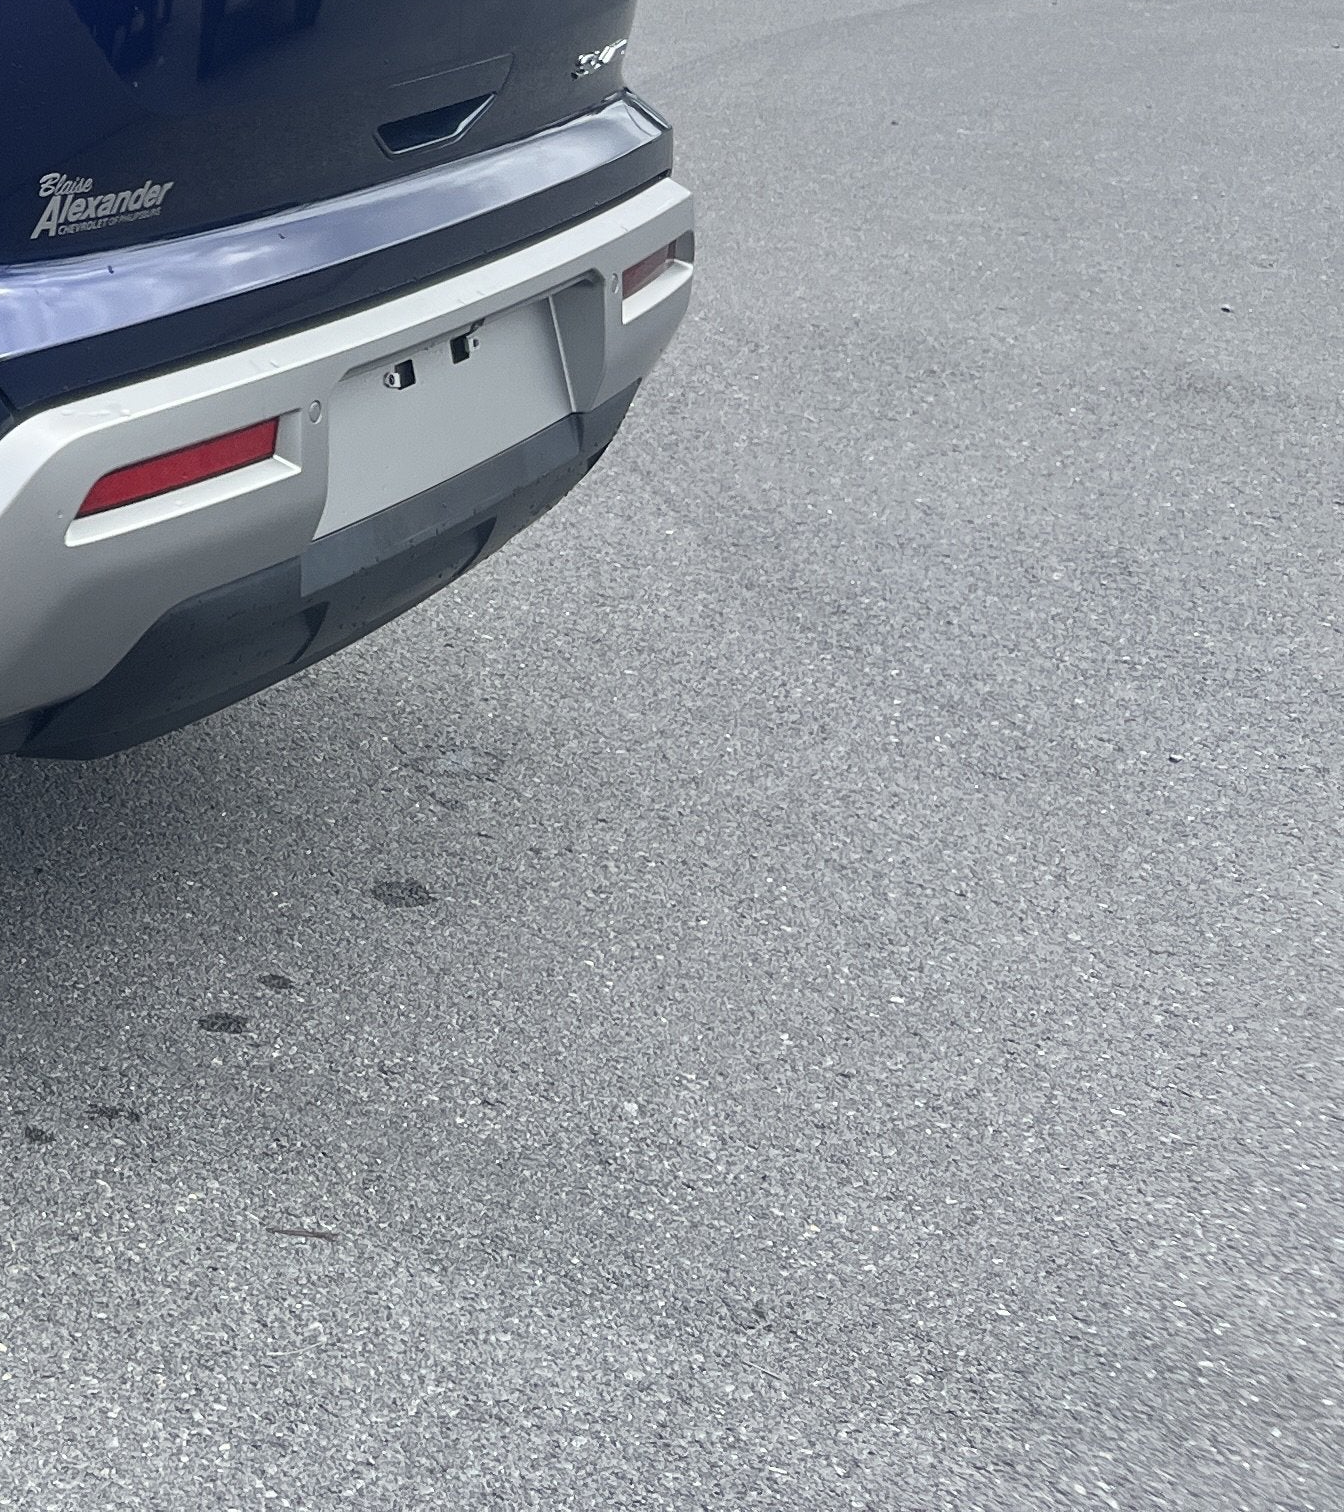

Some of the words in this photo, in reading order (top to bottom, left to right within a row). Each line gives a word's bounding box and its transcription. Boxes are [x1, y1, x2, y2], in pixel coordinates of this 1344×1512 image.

[39, 172, 93, 197] Blaise
[30, 180, 174, 239] Alexander
[58, 219, 106, 235] CHEVROLET
